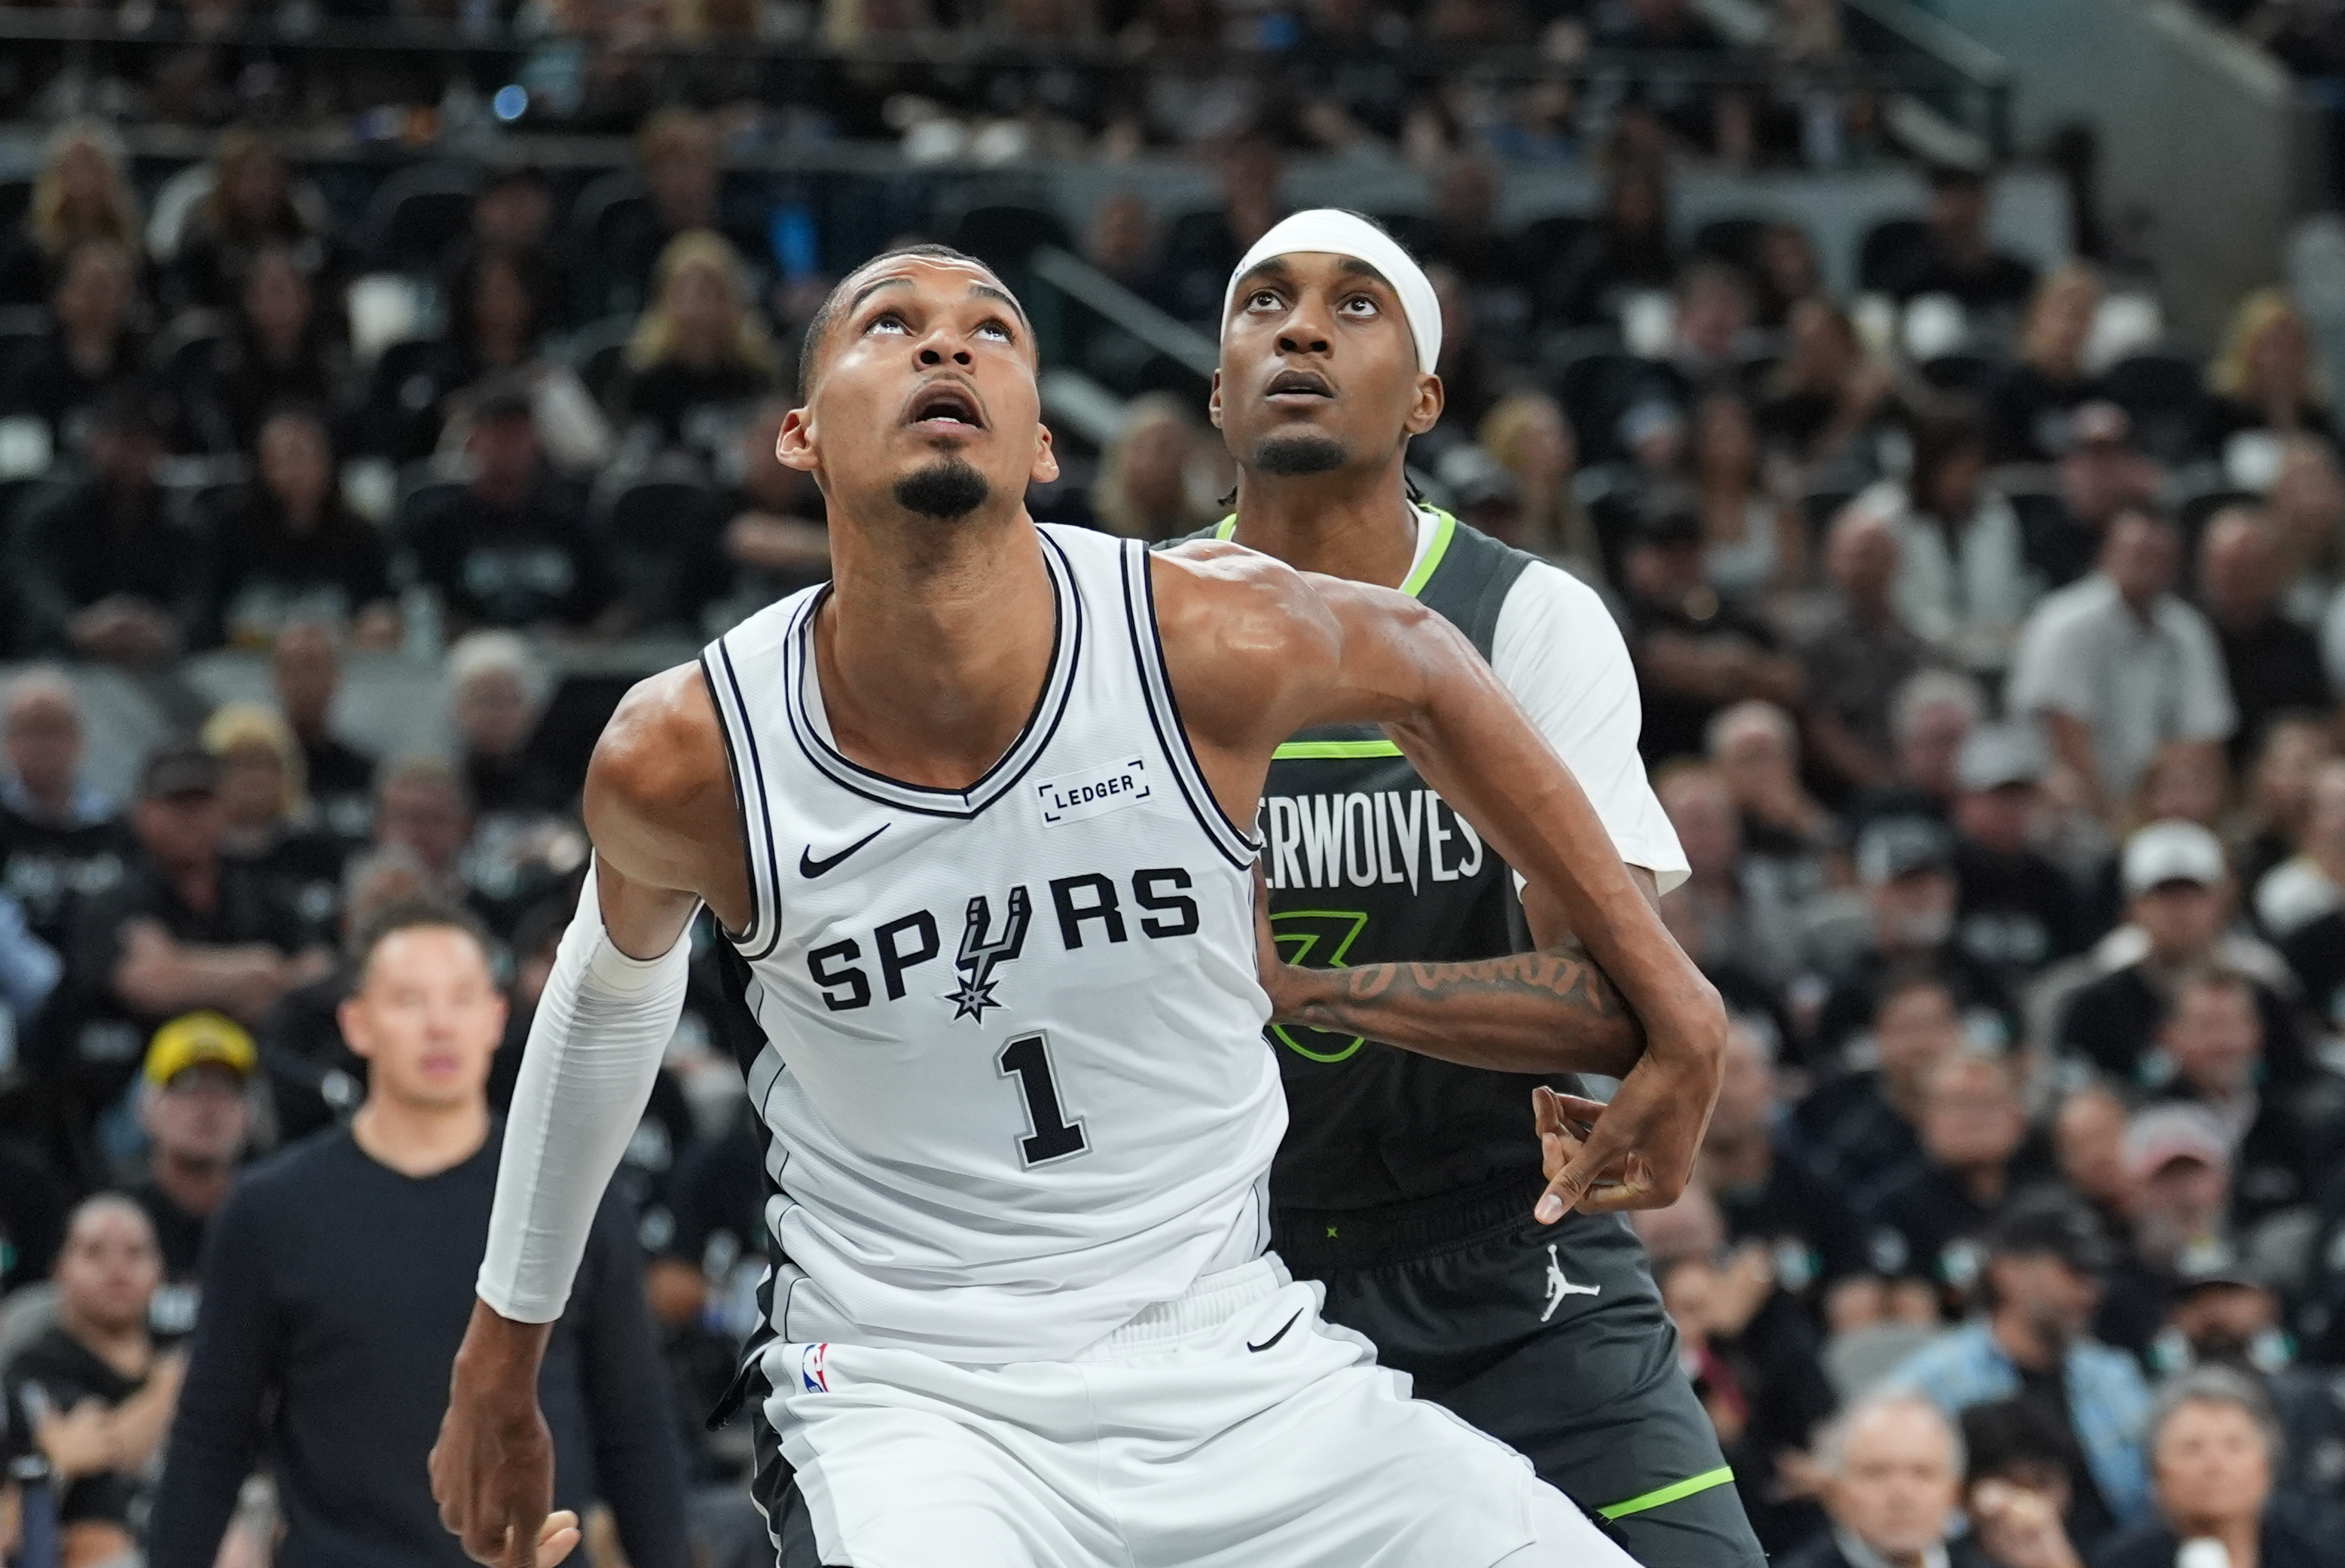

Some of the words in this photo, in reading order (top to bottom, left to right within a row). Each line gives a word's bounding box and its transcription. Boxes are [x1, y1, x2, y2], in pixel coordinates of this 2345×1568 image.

[1055, 775, 1134, 809] LEDGER
[808, 868, 1199, 1024] SPURS
[993, 1029, 1093, 1173] 1
